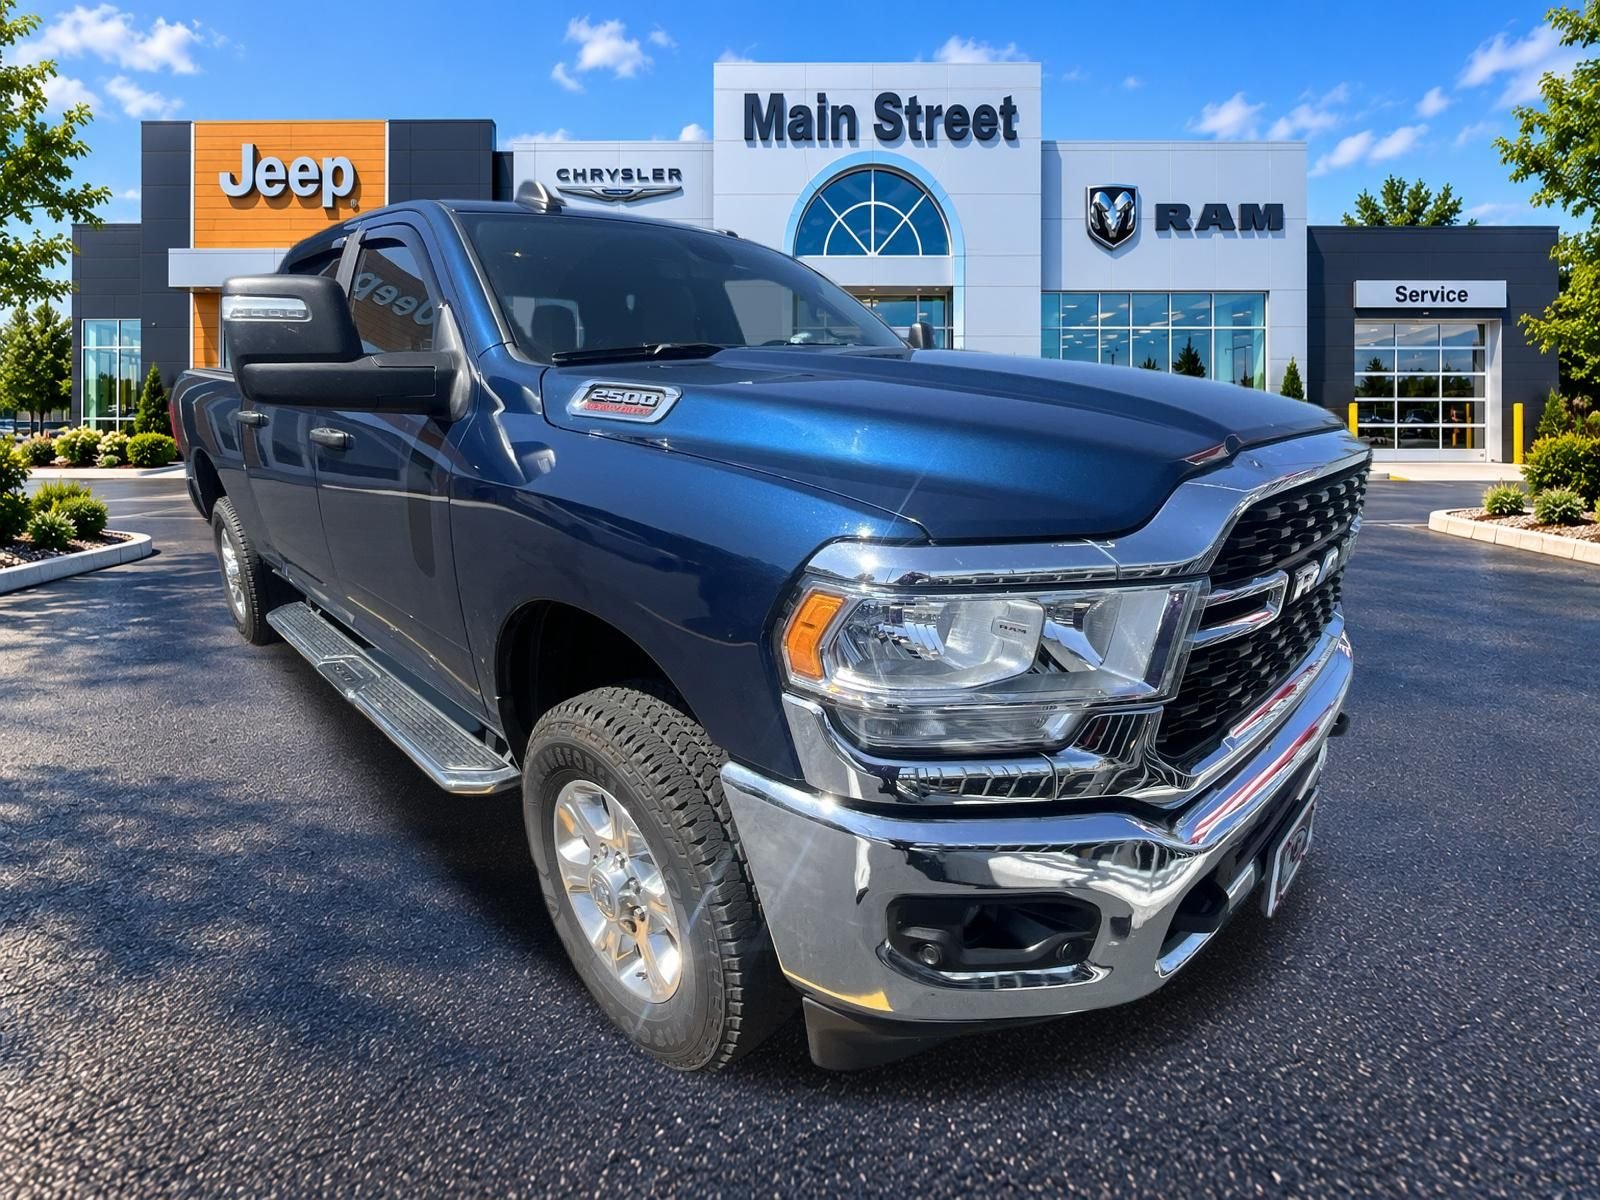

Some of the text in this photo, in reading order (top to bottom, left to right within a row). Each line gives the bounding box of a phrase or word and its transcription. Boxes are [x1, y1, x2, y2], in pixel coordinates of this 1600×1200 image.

[744, 91, 1018, 141] Main Street
[219, 143, 355, 208] Jeep
[556, 168, 683, 183] CHRYSLER
[1155, 203, 1284, 231] RAM
[1395, 285, 1469, 303] Service
[591, 389, 660, 406] 2500
